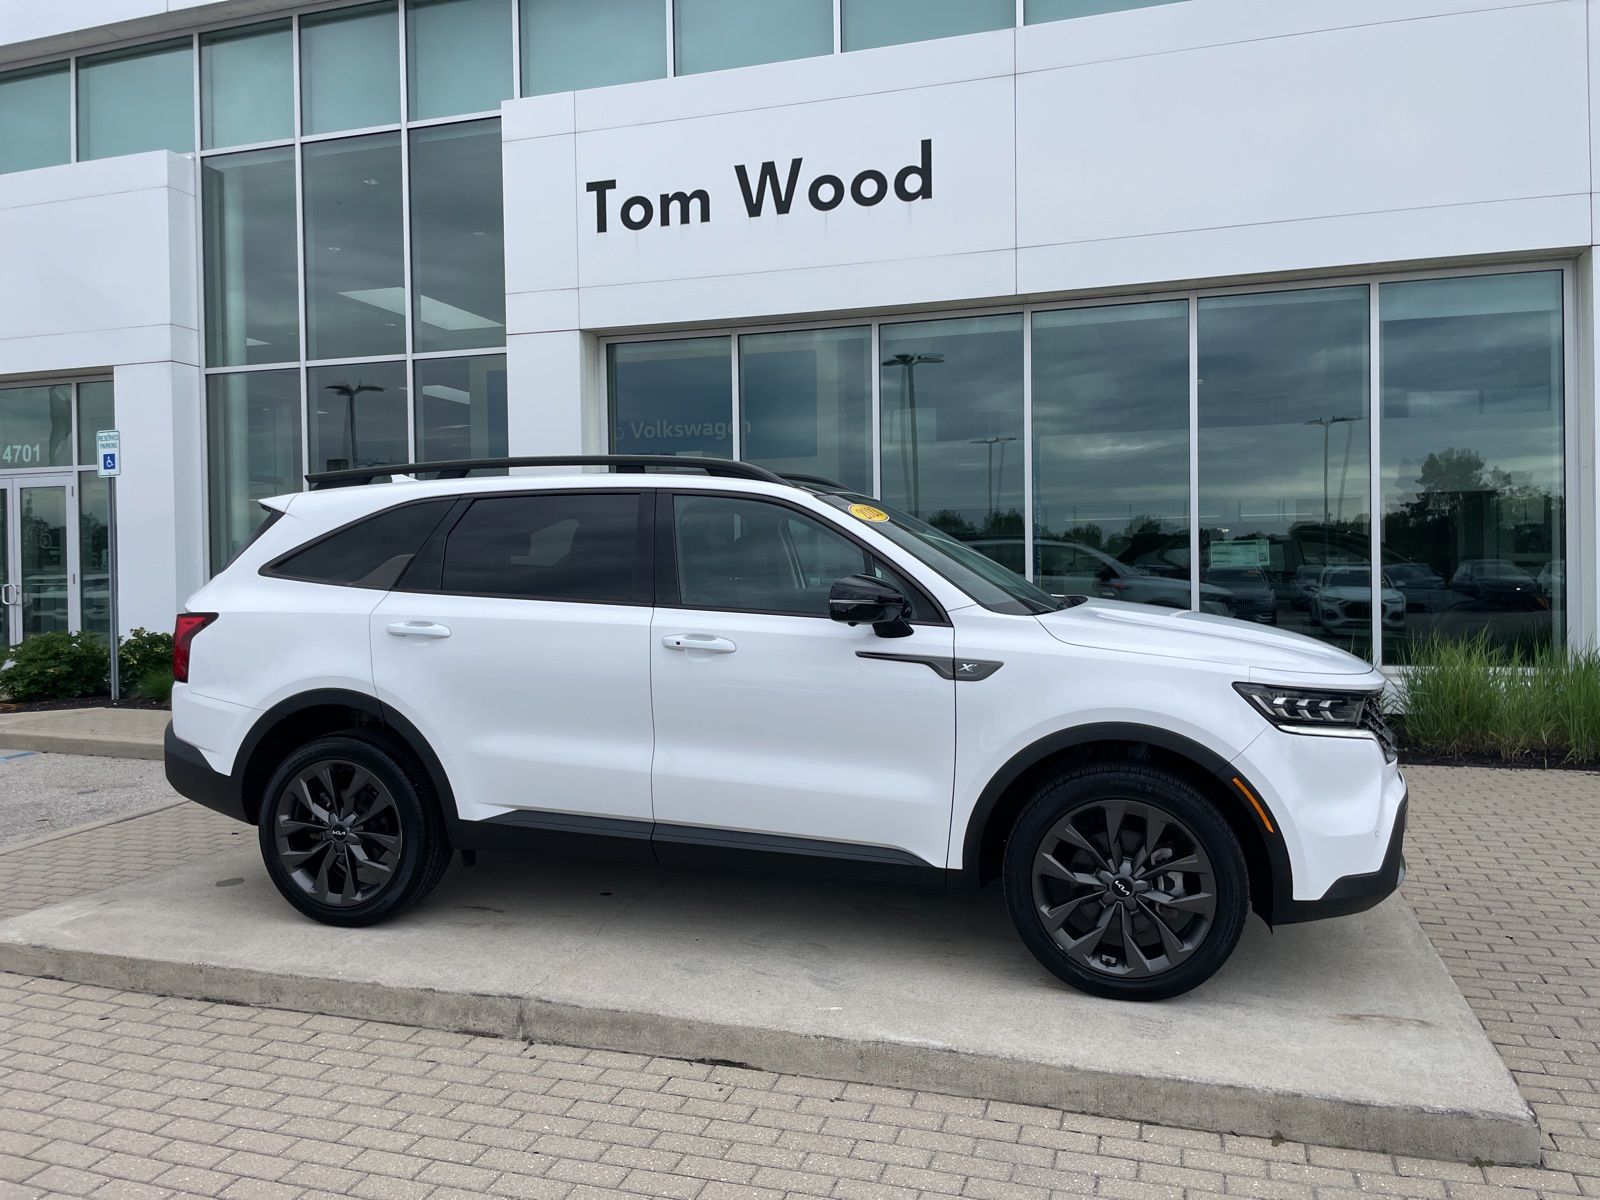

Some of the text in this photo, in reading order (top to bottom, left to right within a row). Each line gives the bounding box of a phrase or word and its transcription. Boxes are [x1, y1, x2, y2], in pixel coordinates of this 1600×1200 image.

[586, 138, 933, 234] Tom Wood
[2, 443, 41, 463] 4701
